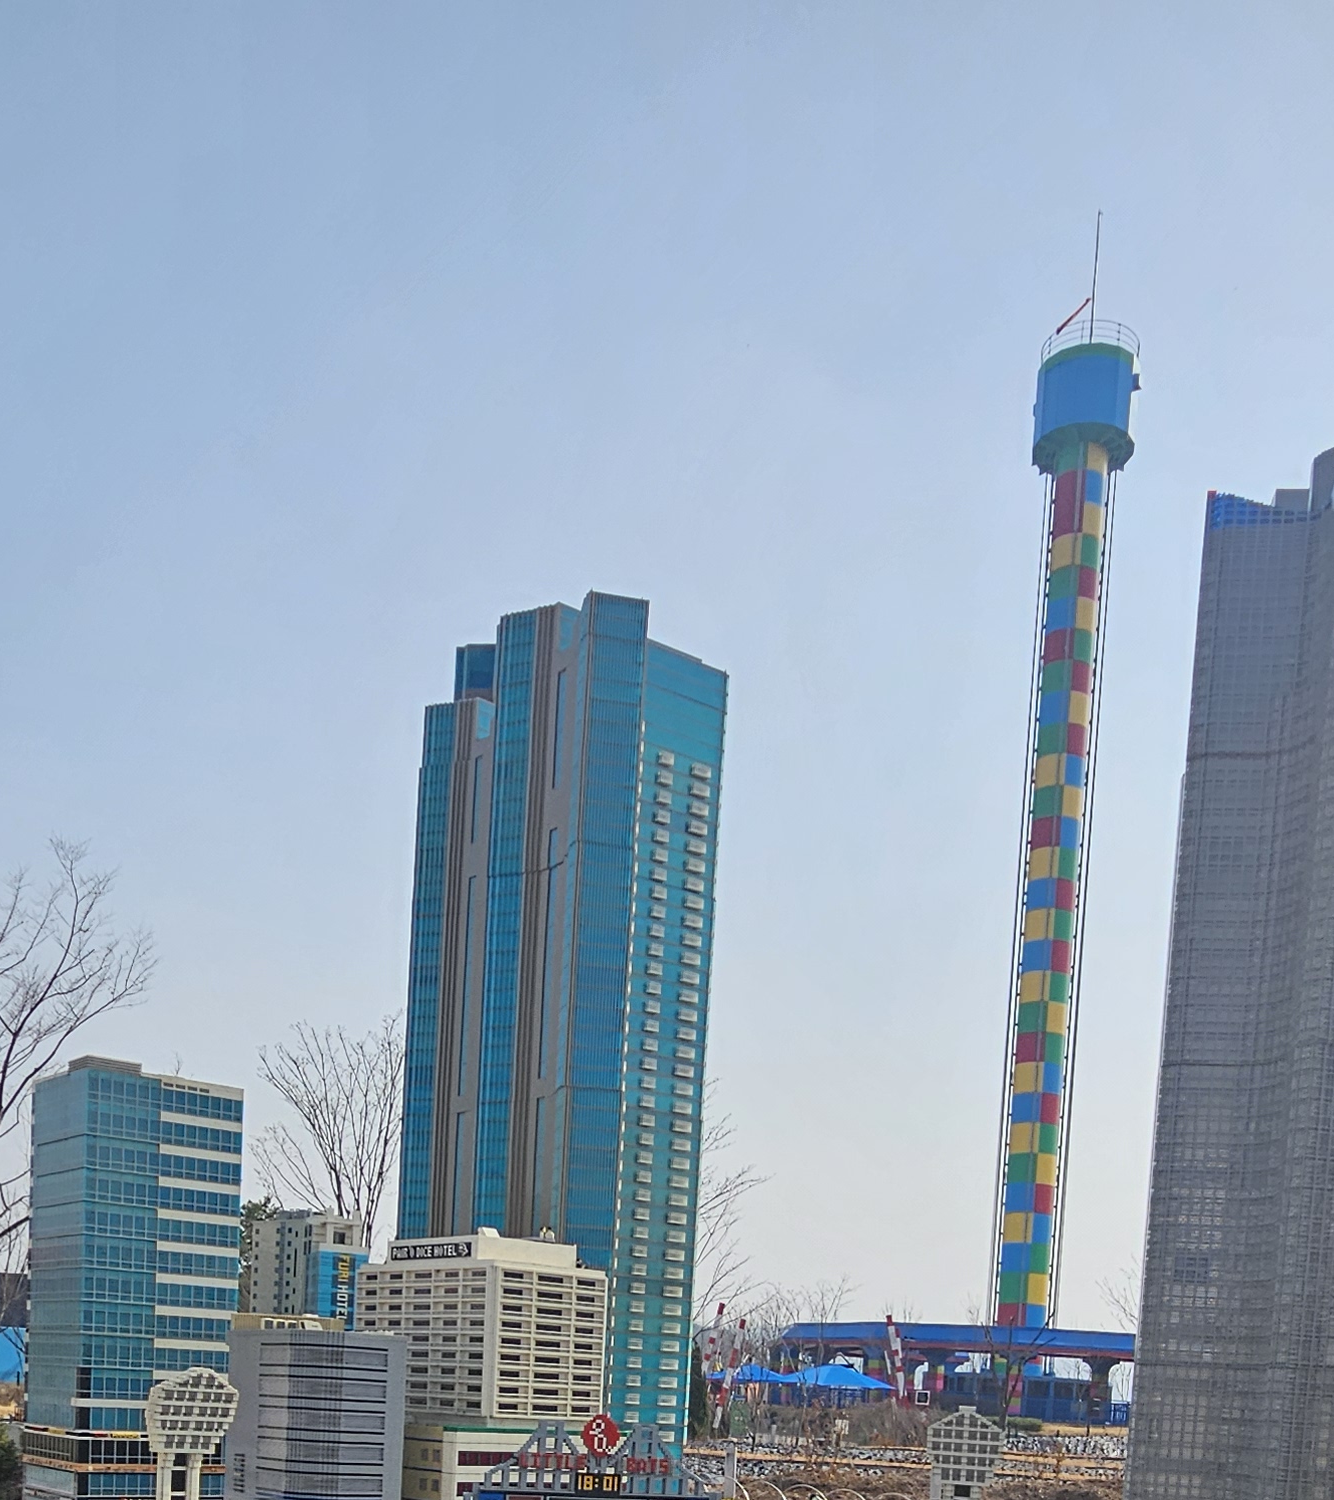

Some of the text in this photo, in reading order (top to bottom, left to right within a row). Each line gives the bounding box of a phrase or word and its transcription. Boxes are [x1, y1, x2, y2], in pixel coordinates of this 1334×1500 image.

[416, 1246, 432, 1258] DICE
[433, 1244, 457, 1257] HOTEL
[338, 1255, 350, 1282] FURI
[519, 1452, 670, 1473] LITTLE BATS
